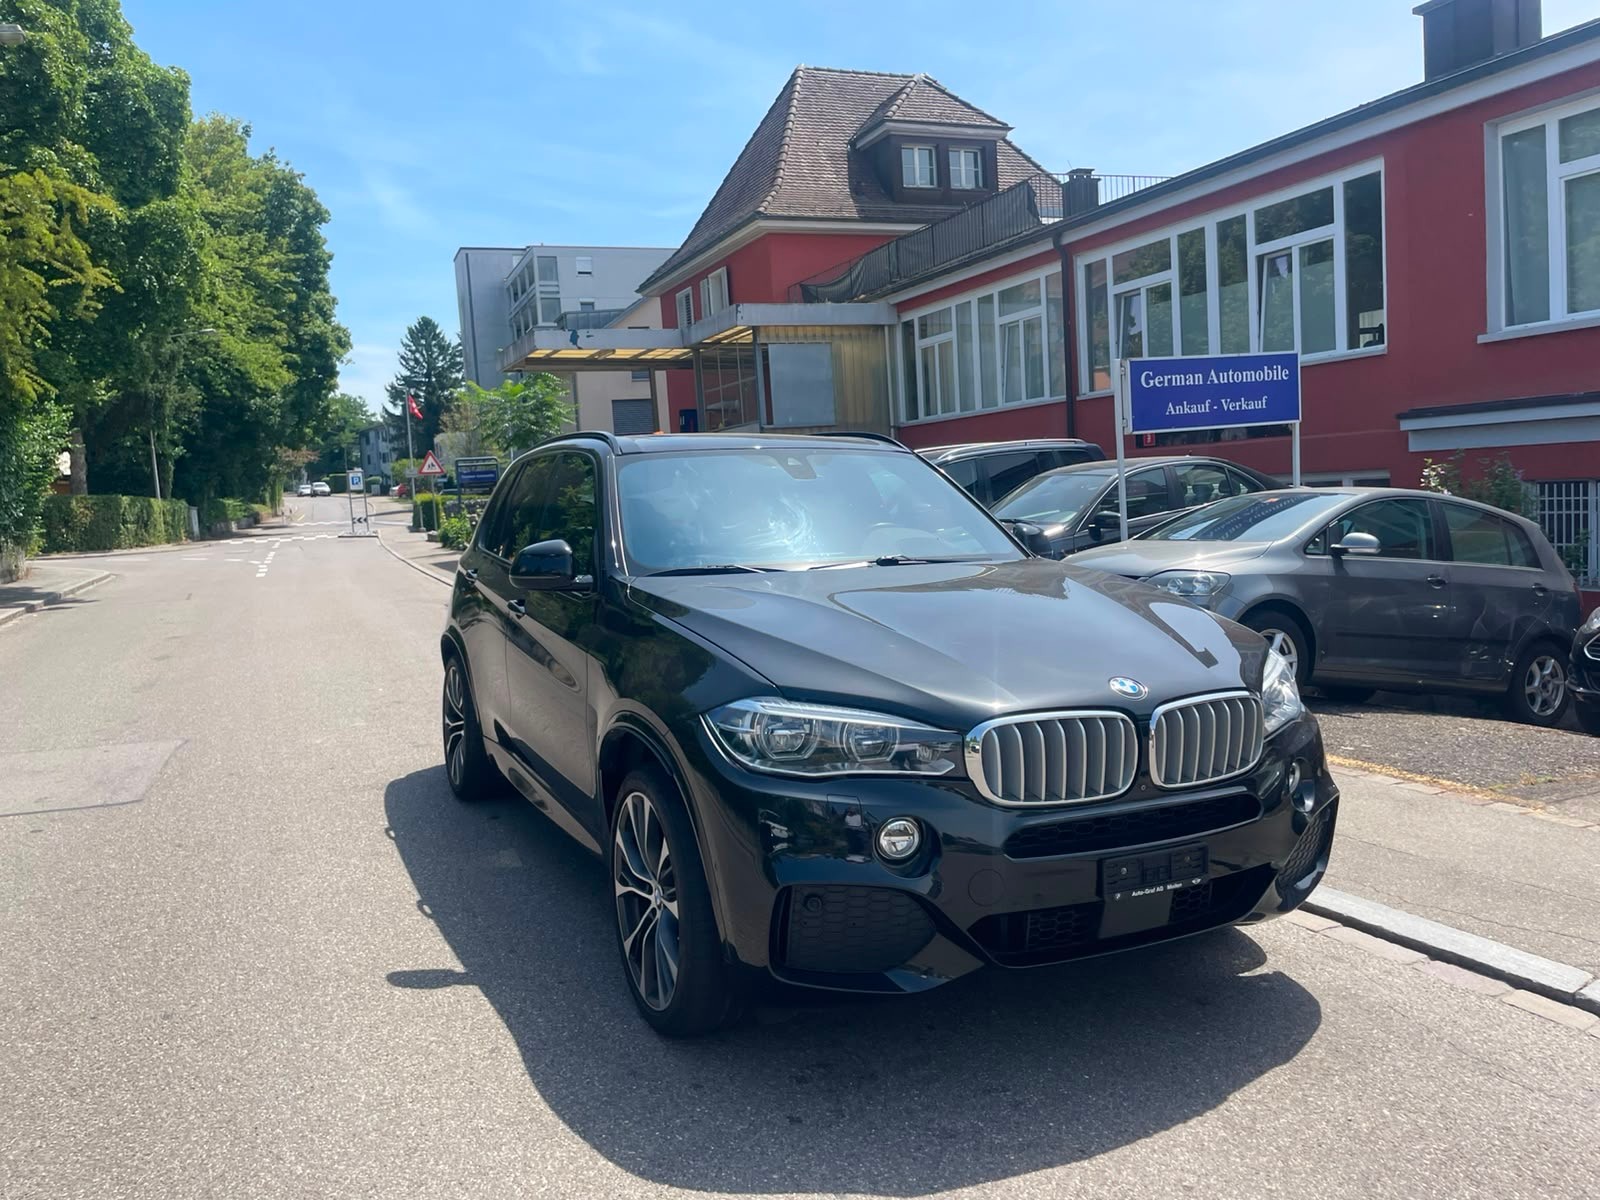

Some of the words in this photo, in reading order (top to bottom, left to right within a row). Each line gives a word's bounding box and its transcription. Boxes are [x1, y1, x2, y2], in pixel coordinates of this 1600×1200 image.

[1141, 370, 1203, 388] German
[1207, 365, 1289, 385] Automobile
[1166, 399, 1210, 416] Ankauf
[1221, 396, 1267, 411] Verkauf
[1131, 887, 1156, 897] Auto-Graf
